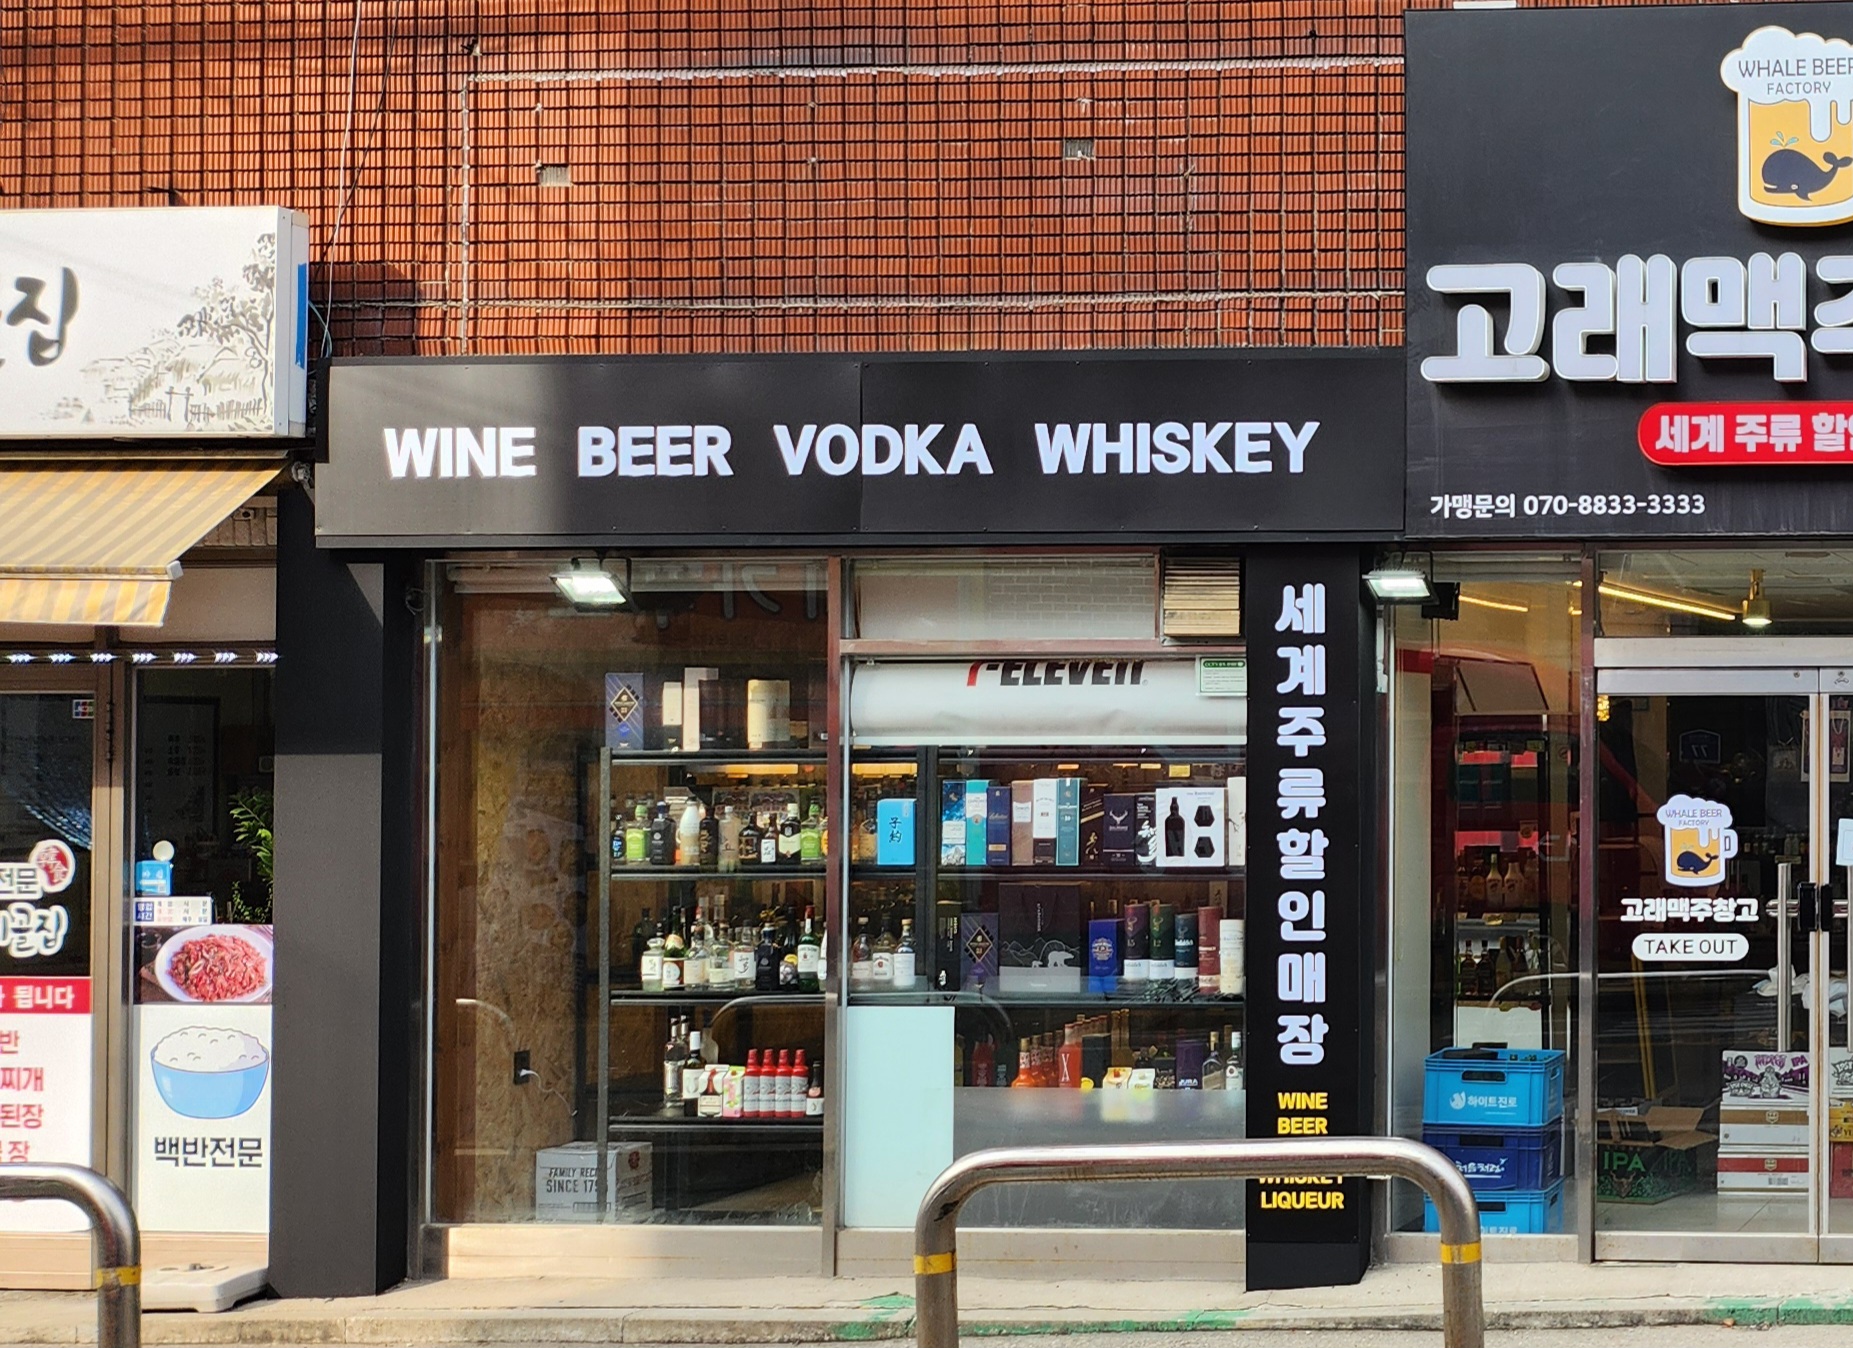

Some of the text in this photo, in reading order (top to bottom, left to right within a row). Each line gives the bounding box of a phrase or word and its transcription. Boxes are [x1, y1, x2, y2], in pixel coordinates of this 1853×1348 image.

[1738, 58, 1807, 78] WHALE
[1766, 81, 1831, 95] FACTORY
[6, 266, 80, 366] 집
[1655, 413, 1725, 453] 세계
[1734, 413, 1803, 453] 주류
[383, 421, 1321, 478] WINE BEER VODKA WHISKEY
[1430, 494, 1706, 519] 가맹문의 070-8833-3333
[1665, 808, 1723, 818] WHALE BEER
[1620, 897, 1760, 923] 고래맥주창고
[0, 907, 63, 948] 골집
[1644, 939, 1738, 955] TAKE OUT
[13, 984, 76, 1009] 됩니다
[1277, 1092, 1328, 1110] WINE
[1467, 1094, 1518, 1108] 하이트진로
[1277, 1117, 1329, 1135] BEER
[153, 1136, 264, 1168] 백반전문
[1603, 1151, 1647, 1172] IPA
[549, 1167, 577, 1178] FAMILY
[546, 1179, 579, 1193] SINCE
[1260, 1191, 1345, 1209] LIQUEUR
